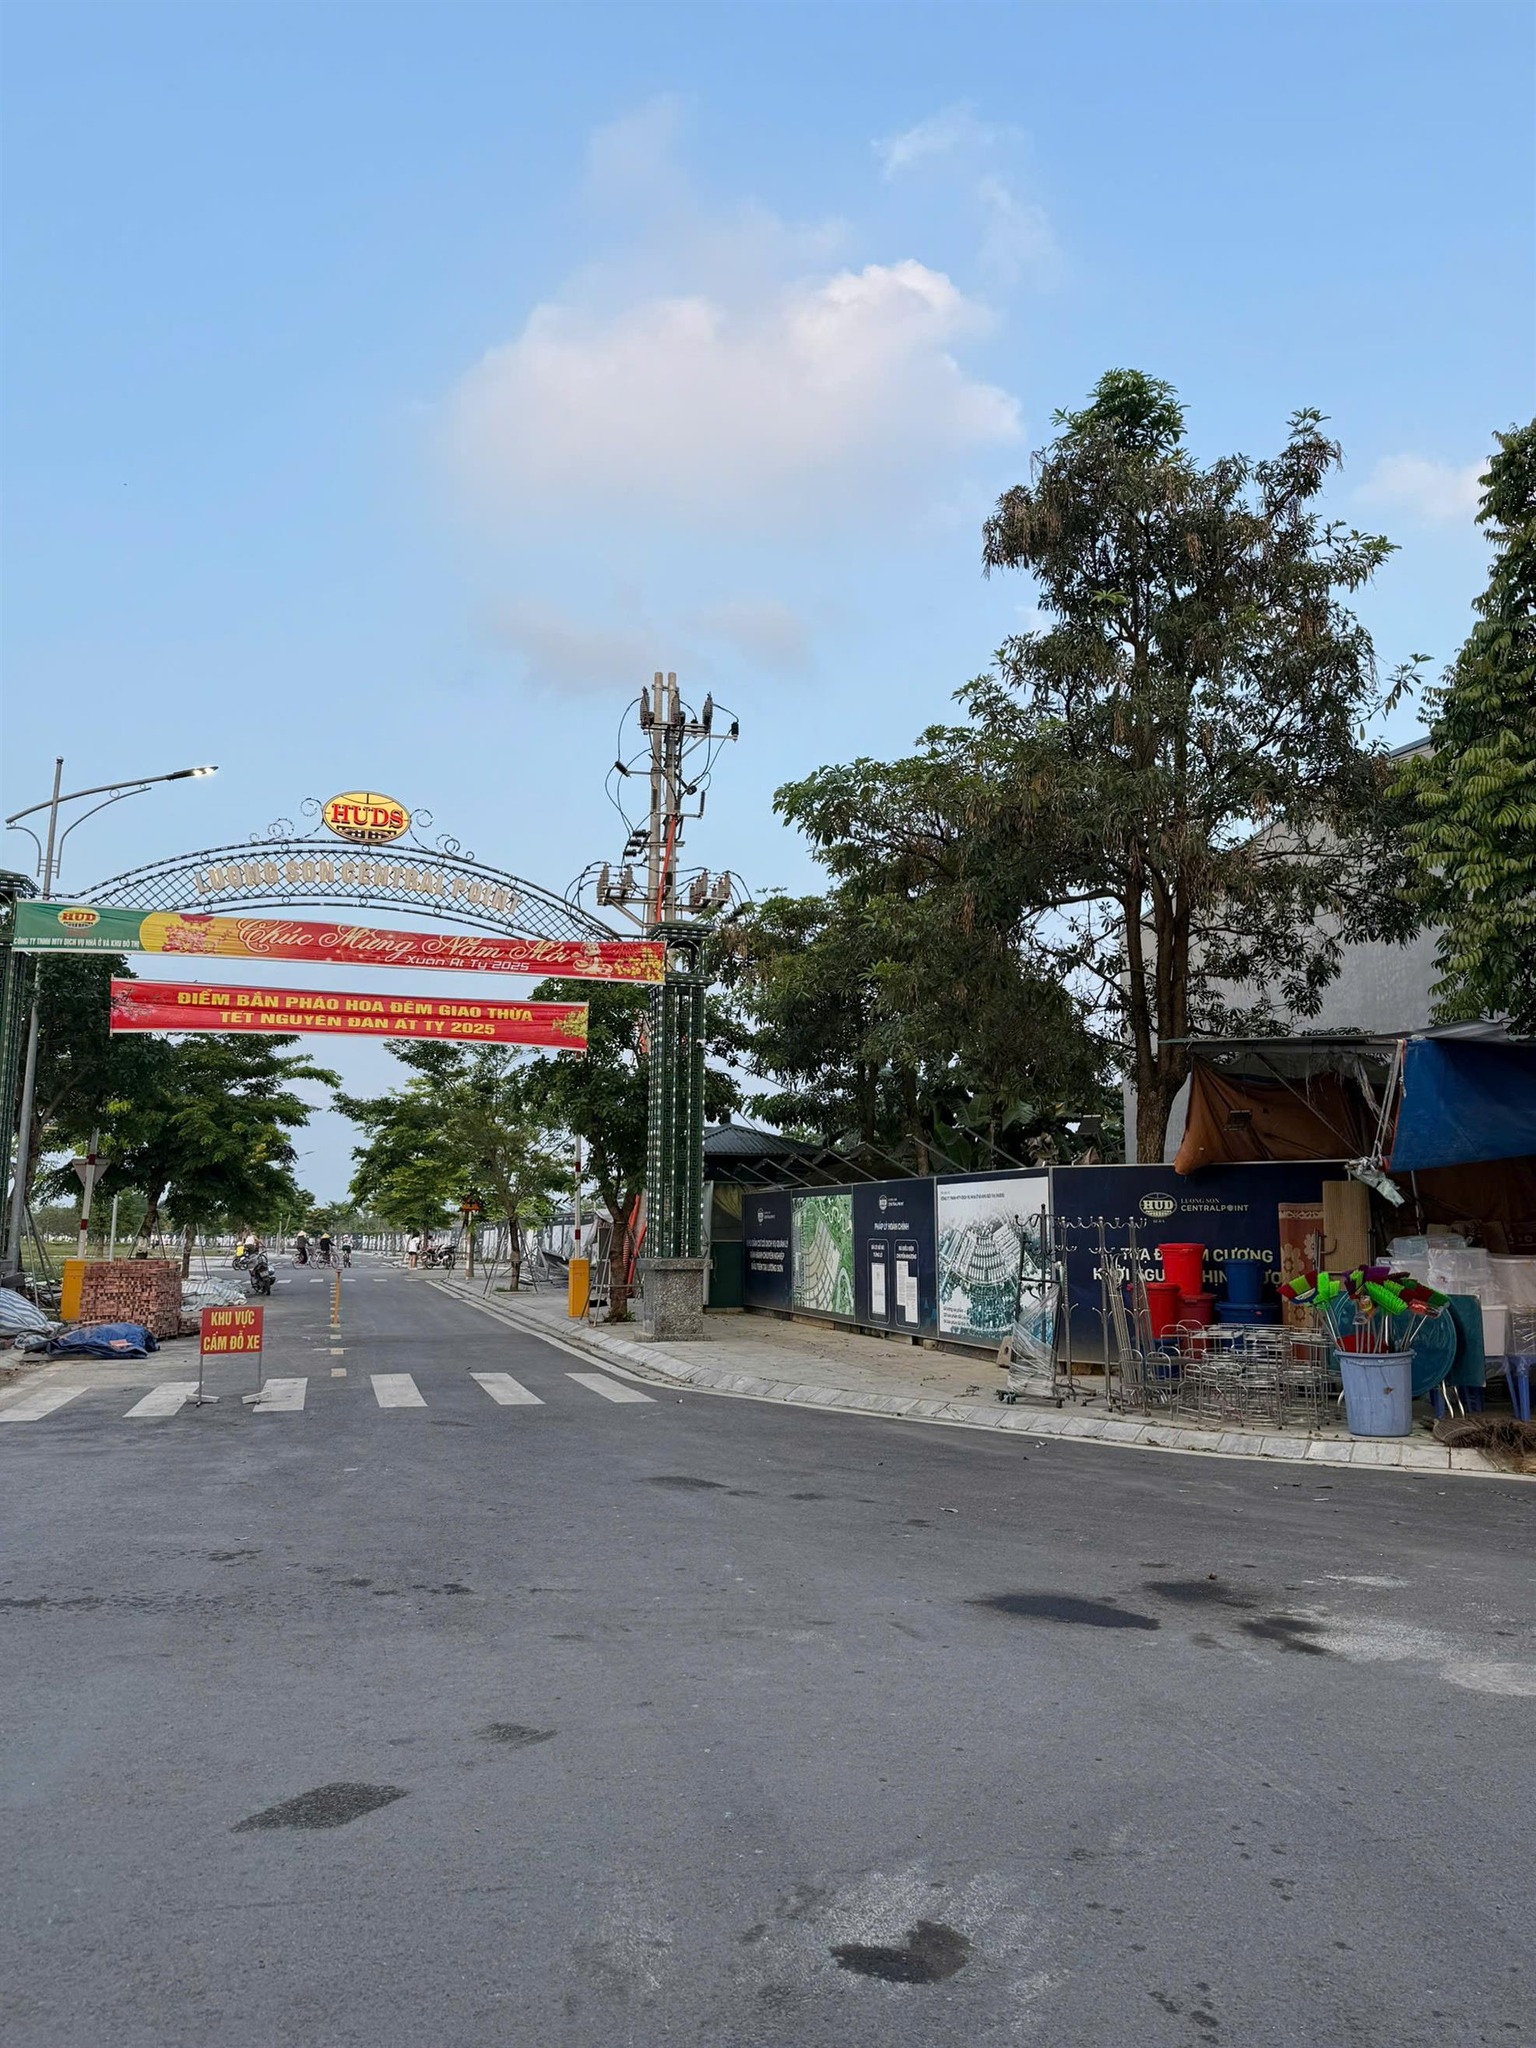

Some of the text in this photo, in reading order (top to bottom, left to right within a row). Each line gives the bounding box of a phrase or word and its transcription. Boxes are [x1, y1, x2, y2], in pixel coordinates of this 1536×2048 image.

[331, 803, 404, 829] HUDS
[341, 862, 446, 896] CENTRAL
[450, 878, 523, 914] POINT
[61, 912, 97, 921] HUD
[236, 919, 314, 953] Chúc
[491, 962, 530, 972] 2025
[177, 988, 230, 1005] ĐIỂM
[285, 994, 340, 1010] PHÁO
[345, 1000, 384, 1013] HOA
[389, 1001, 432, 1015] ĐÊM
[438, 1005, 482, 1018] GIAO
[487, 1007, 533, 1022] THỪA
[260, 1013, 342, 1027] NGUYÊN
[423, 1019, 446, 1034] TỴ
[450, 1022, 496, 1035] 2025
[1143, 1200, 1175, 1211] HUD
[1212, 1247, 1274, 1263] CƯƠNG
[211, 1309, 255, 1328] KHU VỰC
[203, 1330, 260, 1351] CẤM ĐỖ XE
